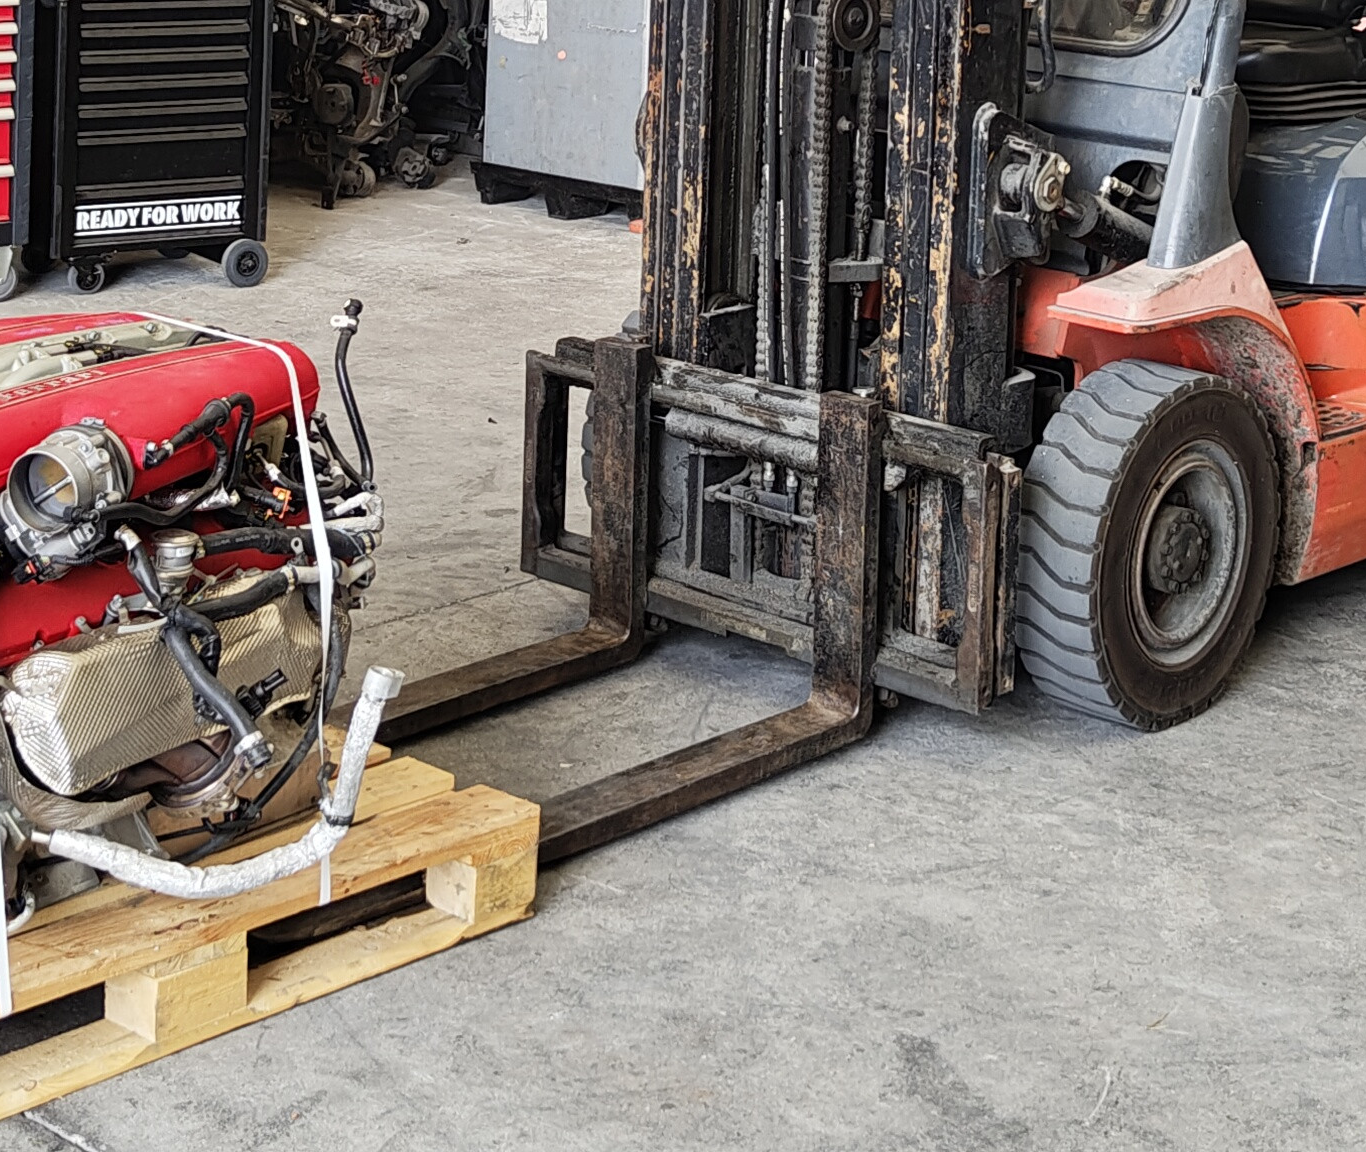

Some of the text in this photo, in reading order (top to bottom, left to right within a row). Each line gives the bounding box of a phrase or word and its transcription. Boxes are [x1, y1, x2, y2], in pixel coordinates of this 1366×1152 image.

[76, 201, 241, 231] READY FOR WORK
